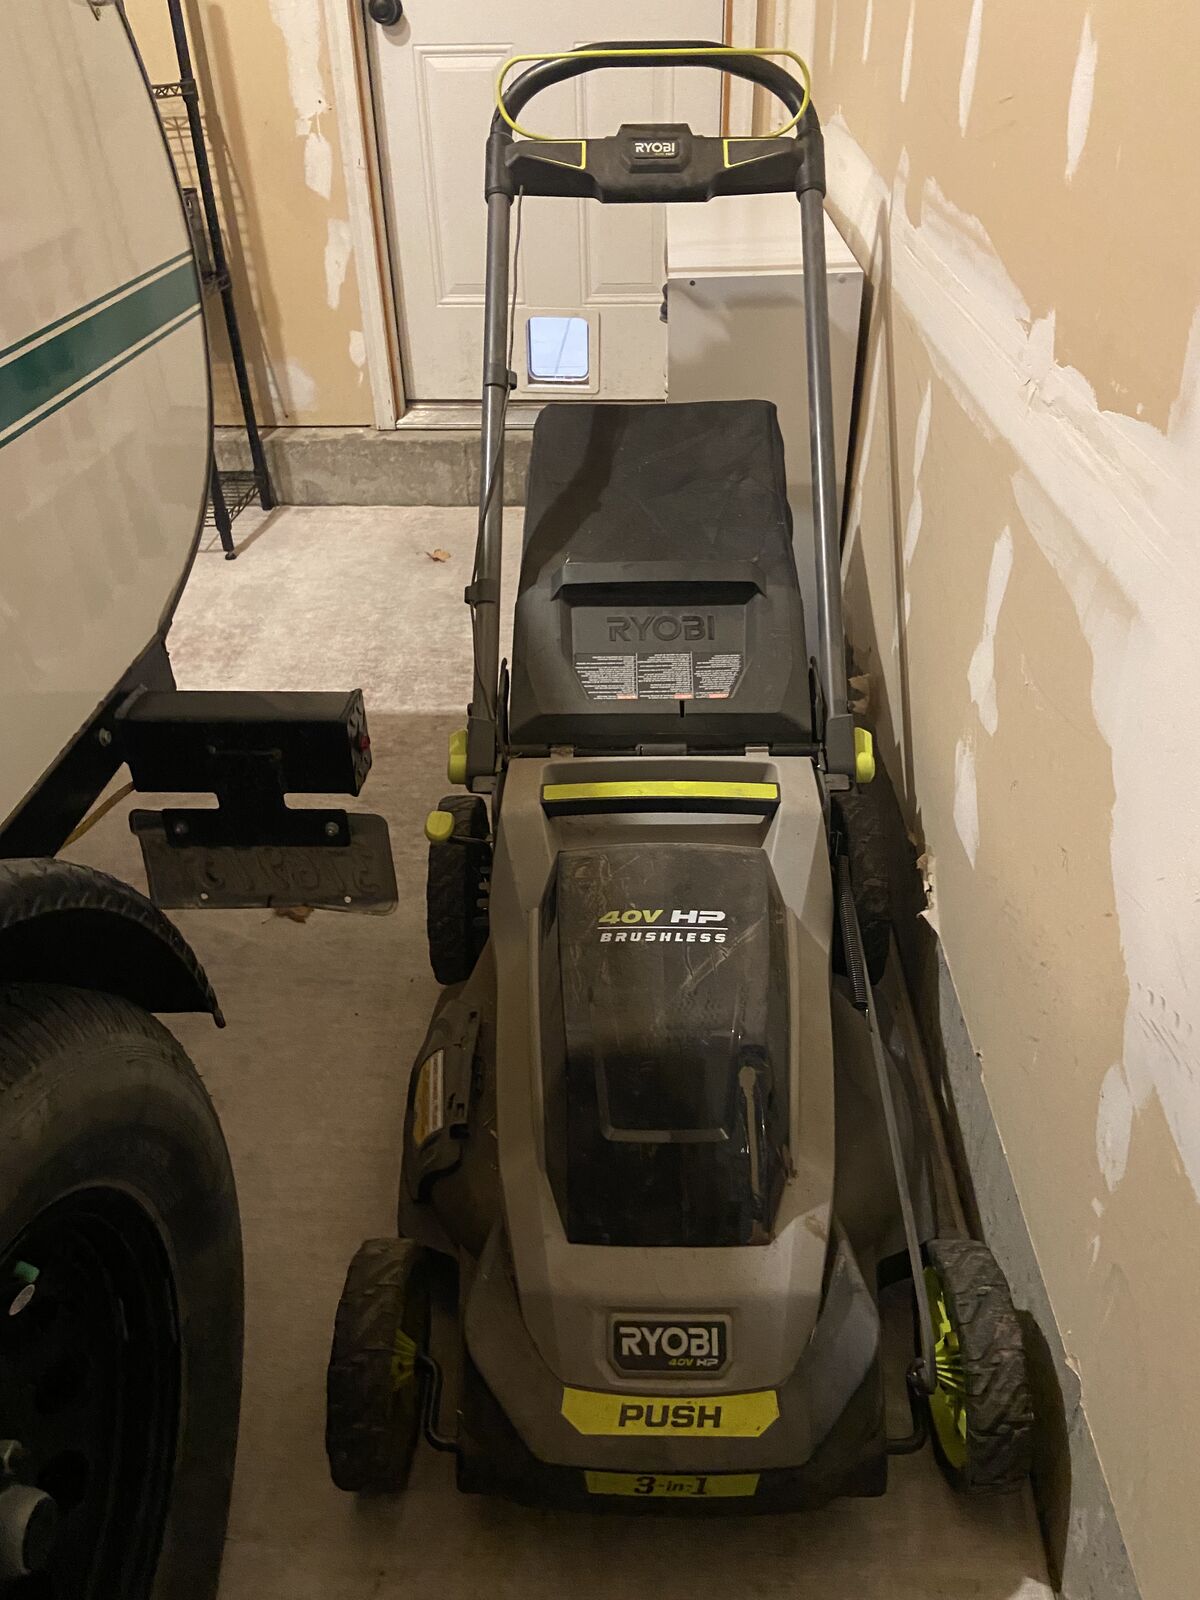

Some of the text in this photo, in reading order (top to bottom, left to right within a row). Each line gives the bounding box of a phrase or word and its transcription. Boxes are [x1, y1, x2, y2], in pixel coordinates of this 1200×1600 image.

[635, 142, 675, 153] RYOBI
[606, 615, 715, 641] RYOBI
[598, 909, 726, 924] 40V HP
[600, 932, 727, 943] BRUSHLESS
[619, 1327, 719, 1357] RYOBI
[668, 1358, 719, 1367] 40V HP
[618, 1404, 722, 1429] PUSH
